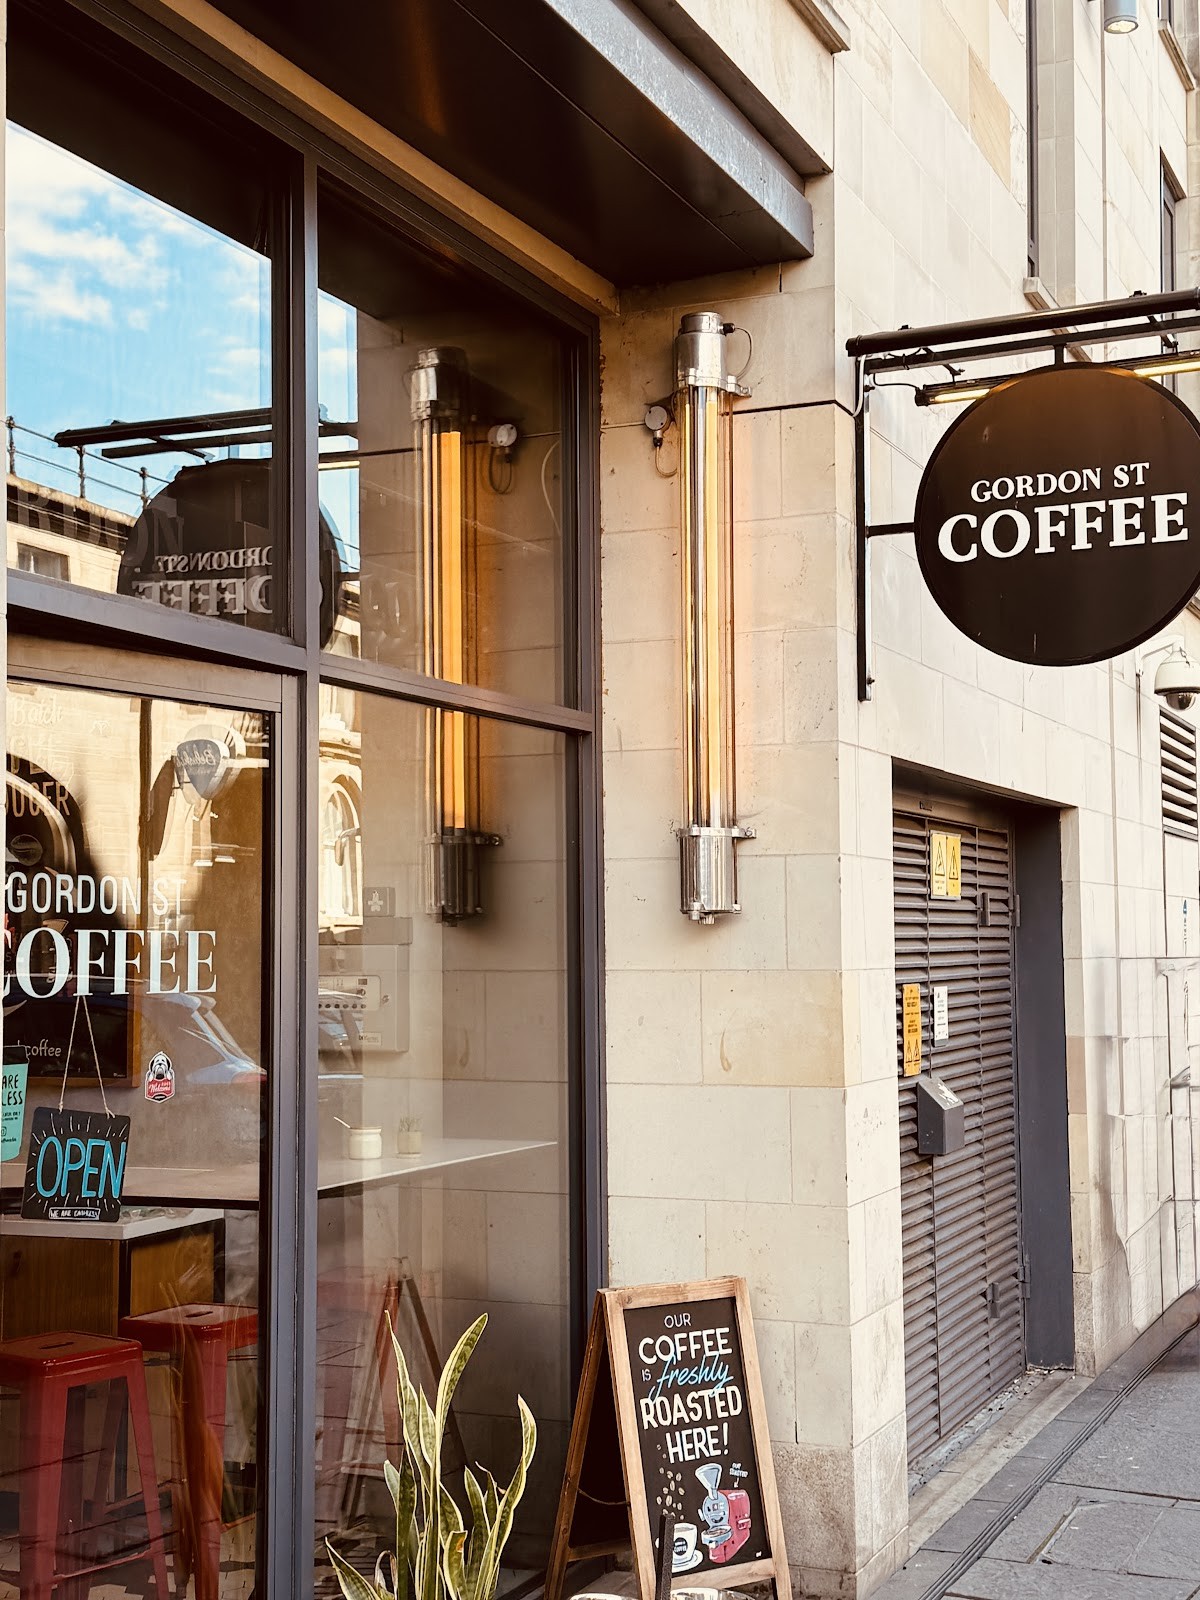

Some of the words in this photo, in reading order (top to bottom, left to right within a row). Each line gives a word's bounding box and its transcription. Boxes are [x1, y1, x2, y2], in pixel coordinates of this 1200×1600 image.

[970, 468, 1102, 503] GORDON
[1113, 462, 1150, 488] ST
[937, 492, 1189, 563] COFFEE
[7, 871, 141, 915] GORDON
[152, 876, 188, 916] ST
[4, 927, 217, 999] OFFEE
[26, 1039, 62, 1057] coffee
[37, 1136, 126, 1198] OPEN
[664, 1313, 692, 1328] OUR
[638, 1327, 733, 1364] COFFEE
[641, 1369, 652, 1382] IS
[649, 1350, 734, 1405] freshly
[640, 1385, 743, 1430] ROASTED
[666, 1422, 729, 1464] HERE!
